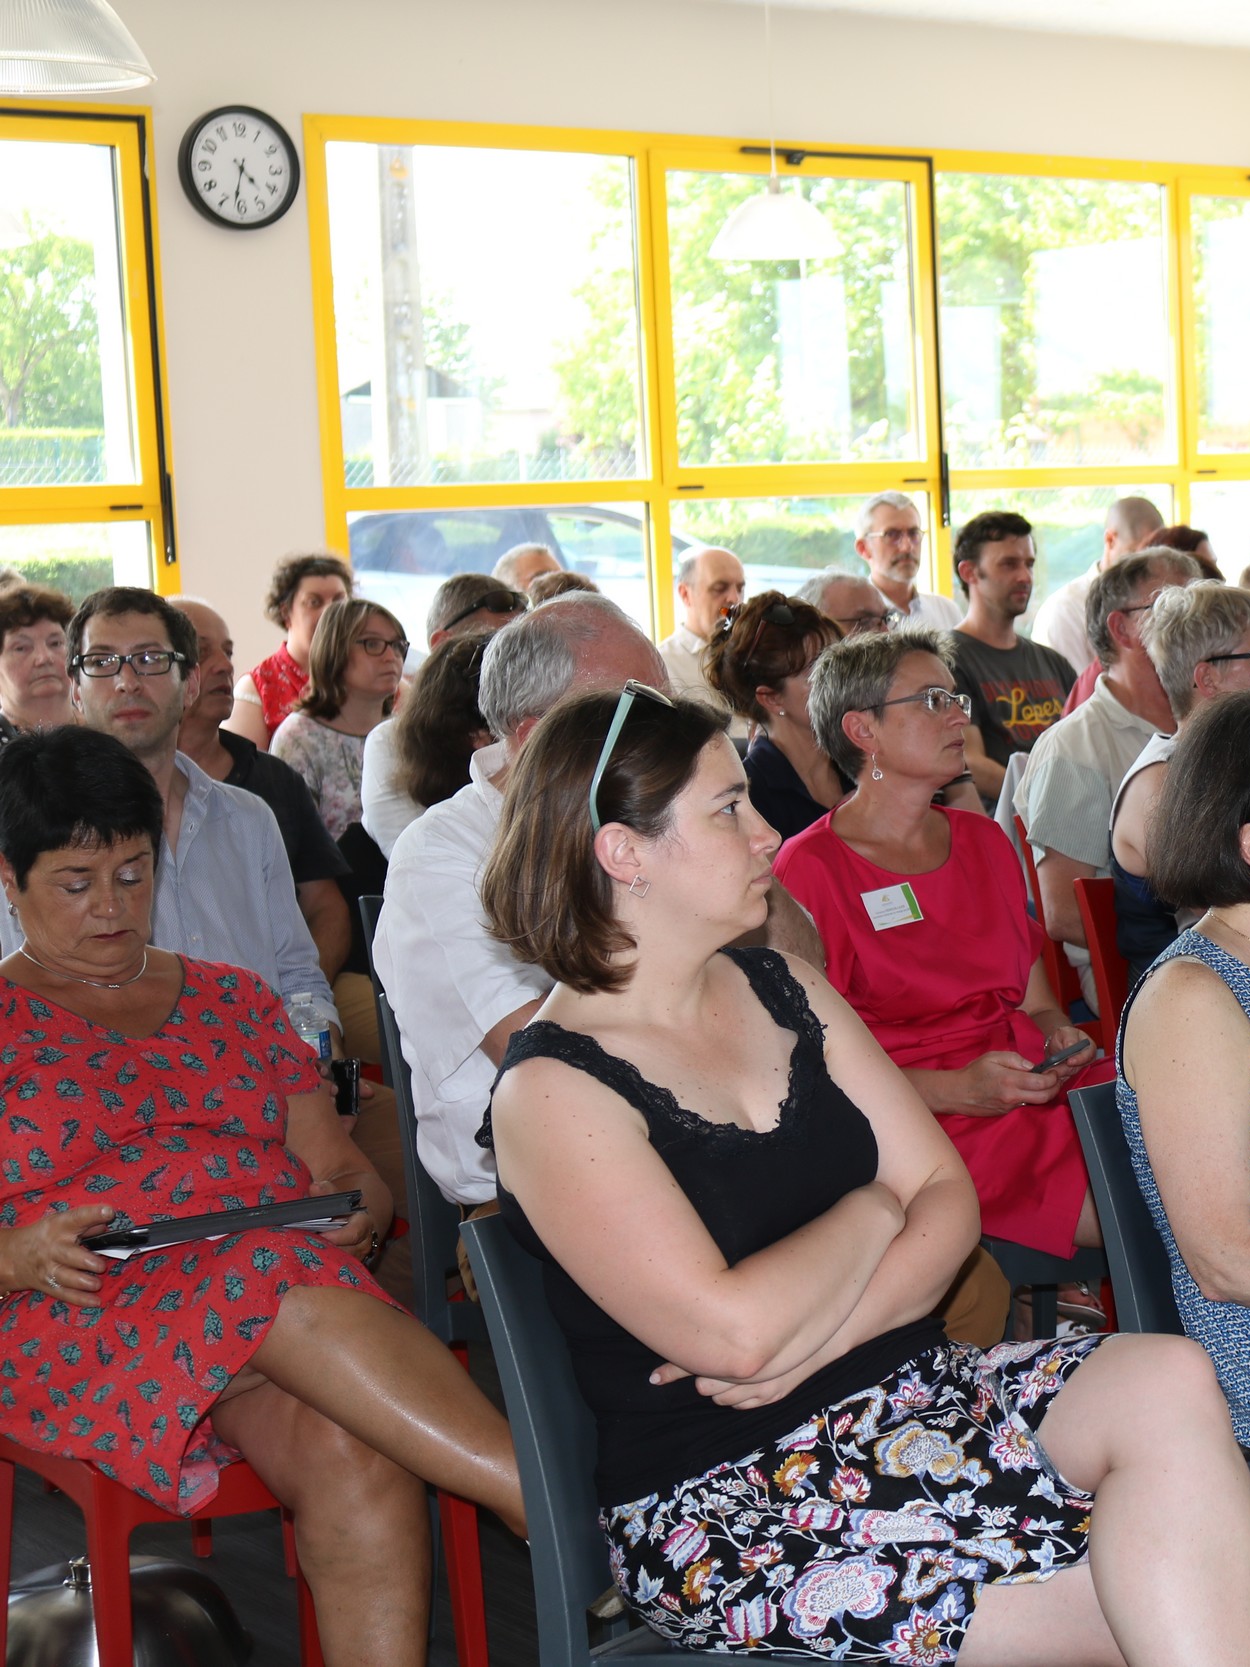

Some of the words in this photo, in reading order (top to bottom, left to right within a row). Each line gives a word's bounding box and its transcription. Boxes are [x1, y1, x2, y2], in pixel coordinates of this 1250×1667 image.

[216, 126, 228, 142] 11
[232, 121, 246, 138] 12
[253, 130, 261, 143] 1
[201, 138, 217, 155] 10
[264, 144, 278, 158] 2
[197, 160, 212, 172] 9
[268, 164, 283, 176] 3
[203, 179, 217, 192] 8
[265, 182, 278, 196] 4
[218, 193, 229, 208] 7
[237, 199, 247, 215] 6
[254, 195, 265, 212] 5
